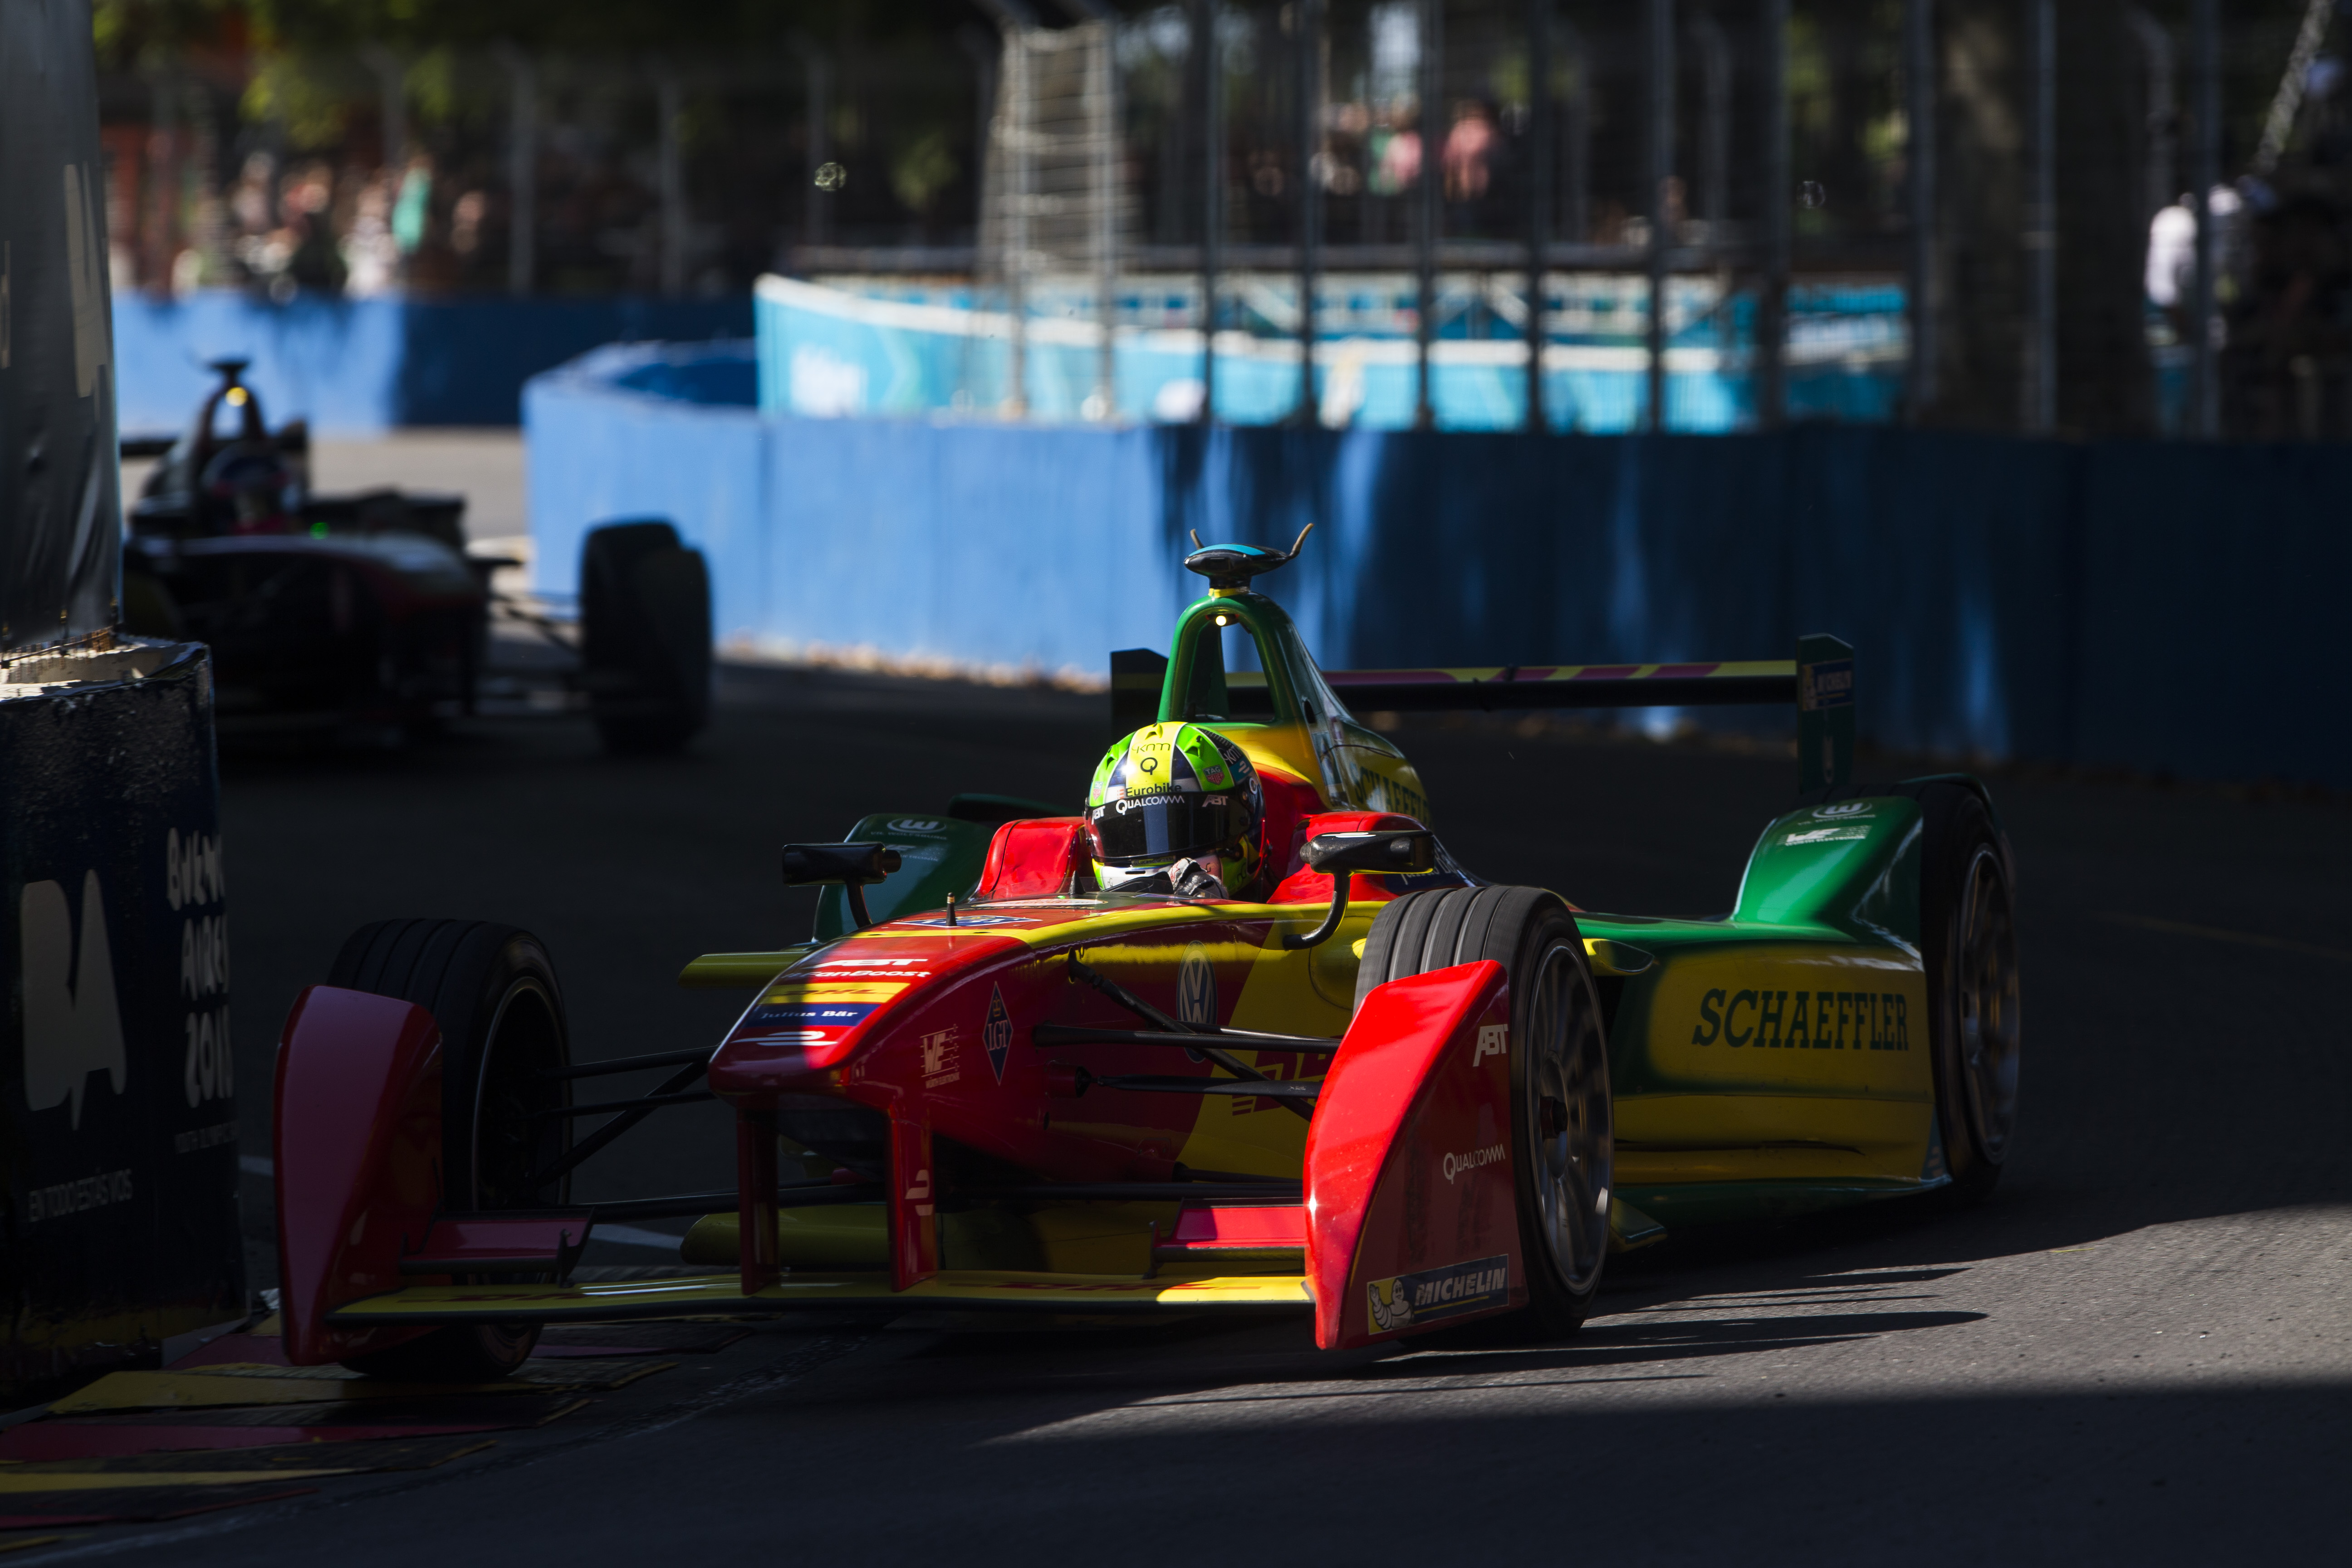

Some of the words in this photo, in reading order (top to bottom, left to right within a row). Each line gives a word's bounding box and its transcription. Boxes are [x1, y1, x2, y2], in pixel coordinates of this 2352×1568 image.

[1140, 757, 1158, 775] Q
[1205, 766, 1221, 775] TAG
[1207, 772, 1225, 785] HEUER
[1126, 783, 1182, 798] Eurobike
[1116, 795, 1185, 815] QUALCOMM
[1201, 794, 1228, 807] ABT
[1091, 805, 1106, 825] ABT
[802, 958, 929, 969] ABT
[780, 970, 933, 978] #FanBoost
[1691, 988, 1908, 1051] SCHAEFFLER
[988, 1019, 1008, 1051] LGT
[1472, 1024, 1509, 1067] ABT
[1443, 1144, 1505, 1185] QUALCOMM
[1414, 1268, 1506, 1306] MICHELIN
